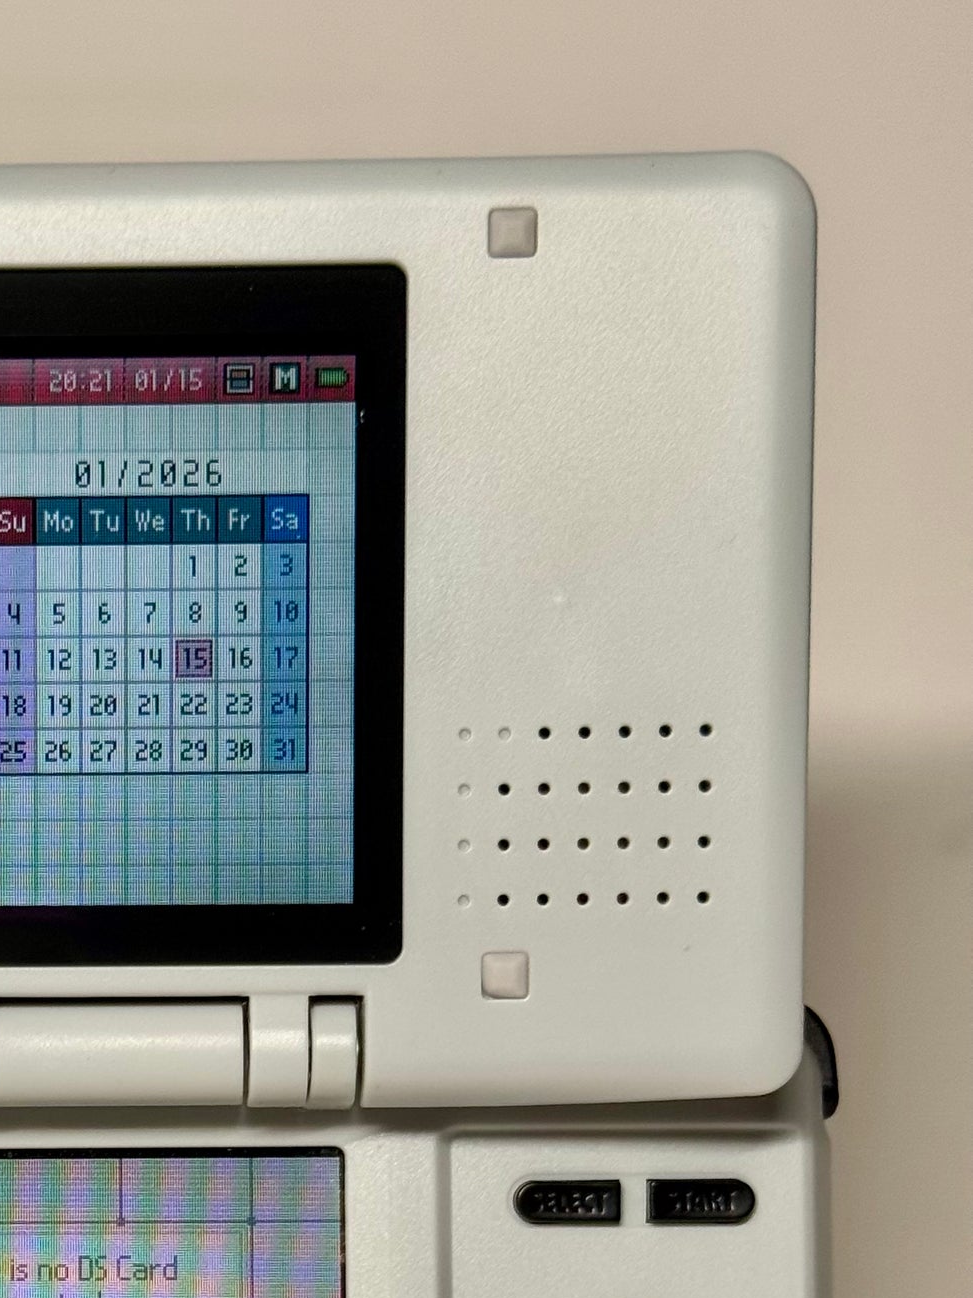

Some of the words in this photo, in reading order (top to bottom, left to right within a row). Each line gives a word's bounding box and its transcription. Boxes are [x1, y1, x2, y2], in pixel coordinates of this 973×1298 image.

[49, 369, 112, 392] 20:21
[135, 368, 202, 391] 01/15
[75, 460, 222, 488] 01/2026
[0, 511, 26, 533] Su
[44, 511, 73, 533] Mo
[90, 510, 119, 532] Tu
[135, 510, 165, 532] We
[181, 509, 210, 532] Th
[228, 509, 250, 531] Fr
[271, 508, 298, 530] Sa
[189, 556, 196, 577] 1
[235, 555, 247, 576] 2
[280, 555, 293, 576] 3
[8, 603, 21, 624] 4
[53, 603, 65, 624] 5
[98, 603, 111, 624] 6
[143, 602, 156, 623] 7
[189, 602, 202, 622] 8
[235, 602, 247, 622] 9
[274, 601, 298, 622] 10
[2, 649, 21, 671] 11
[48, 649, 72, 671] 12
[93, 649, 117, 670] 13
[138, 648, 162, 670] 14
[184, 648, 207, 669] 15
[229, 647, 253, 668] 16
[274, 647, 298, 667] 17
[2, 695, 26, 716] 18
[48, 695, 71, 716] 19
[90, 695, 116, 716] 20
[138, 694, 160, 715] 21
[180, 694, 207, 715] 22
[226, 694, 253, 714] 23
[271, 693, 298, 714] 24
[0, 741, 27, 762] 25
[45, 741, 72, 762] 26
[90, 741, 117, 761] 27
[135, 740, 162, 761] 28
[180, 740, 207, 761] 29
[226, 740, 253, 760] 30
[274, 738, 295, 760] 31
[10, 1259, 28, 1281] is
[37, 1264, 69, 1281] no
[78, 1255, 107, 1281] DS
[117, 1255, 177, 1281] Card
